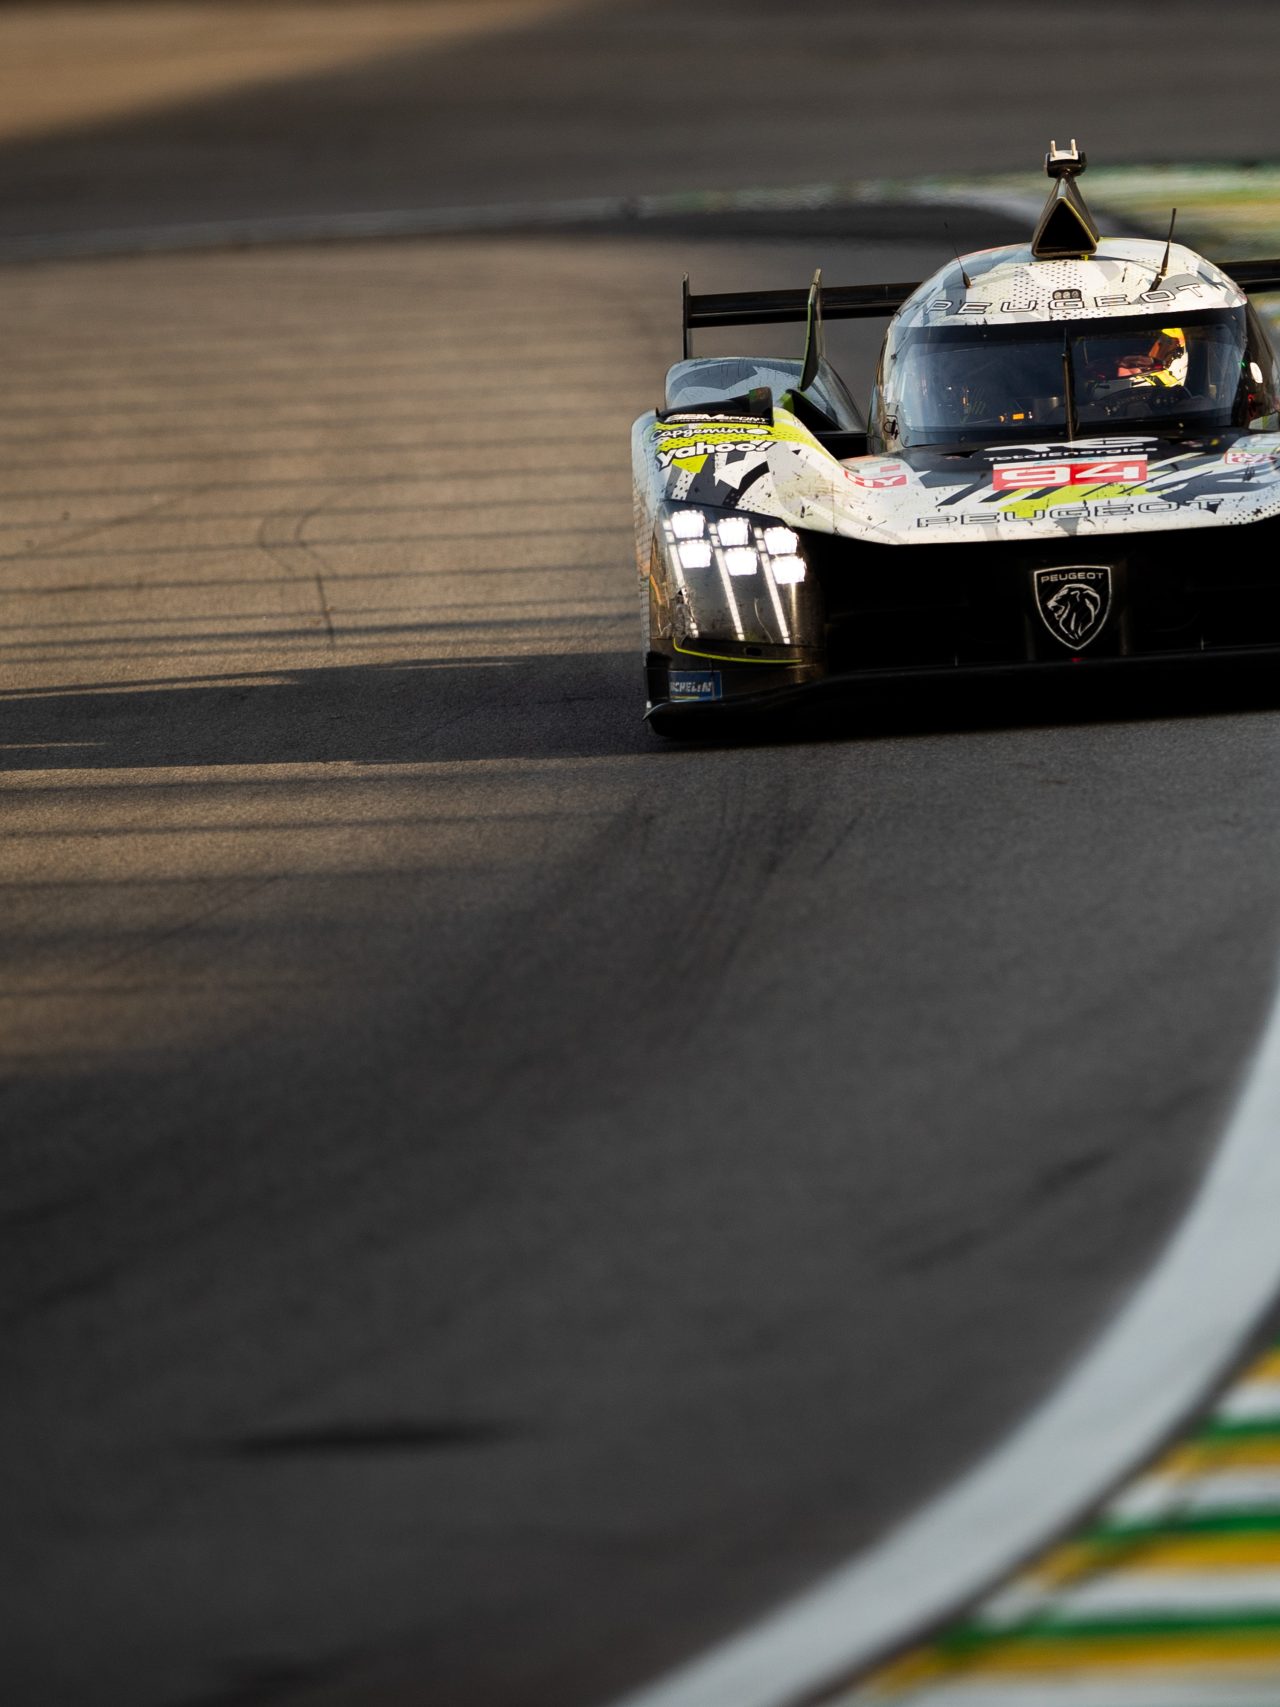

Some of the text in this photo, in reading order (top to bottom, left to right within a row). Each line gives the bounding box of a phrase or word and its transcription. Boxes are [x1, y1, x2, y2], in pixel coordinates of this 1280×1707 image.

[925, 284, 1204, 315] PEUGEOT
[650, 427, 746, 442] Capgemini
[656, 440, 774, 468] yahoo!
[984, 447, 1157, 462] TotalEnergies
[1001, 463, 1140, 488] 94
[916, 498, 1225, 528] PEUGEOT
[1041, 572, 1104, 584] PEUGEOT
